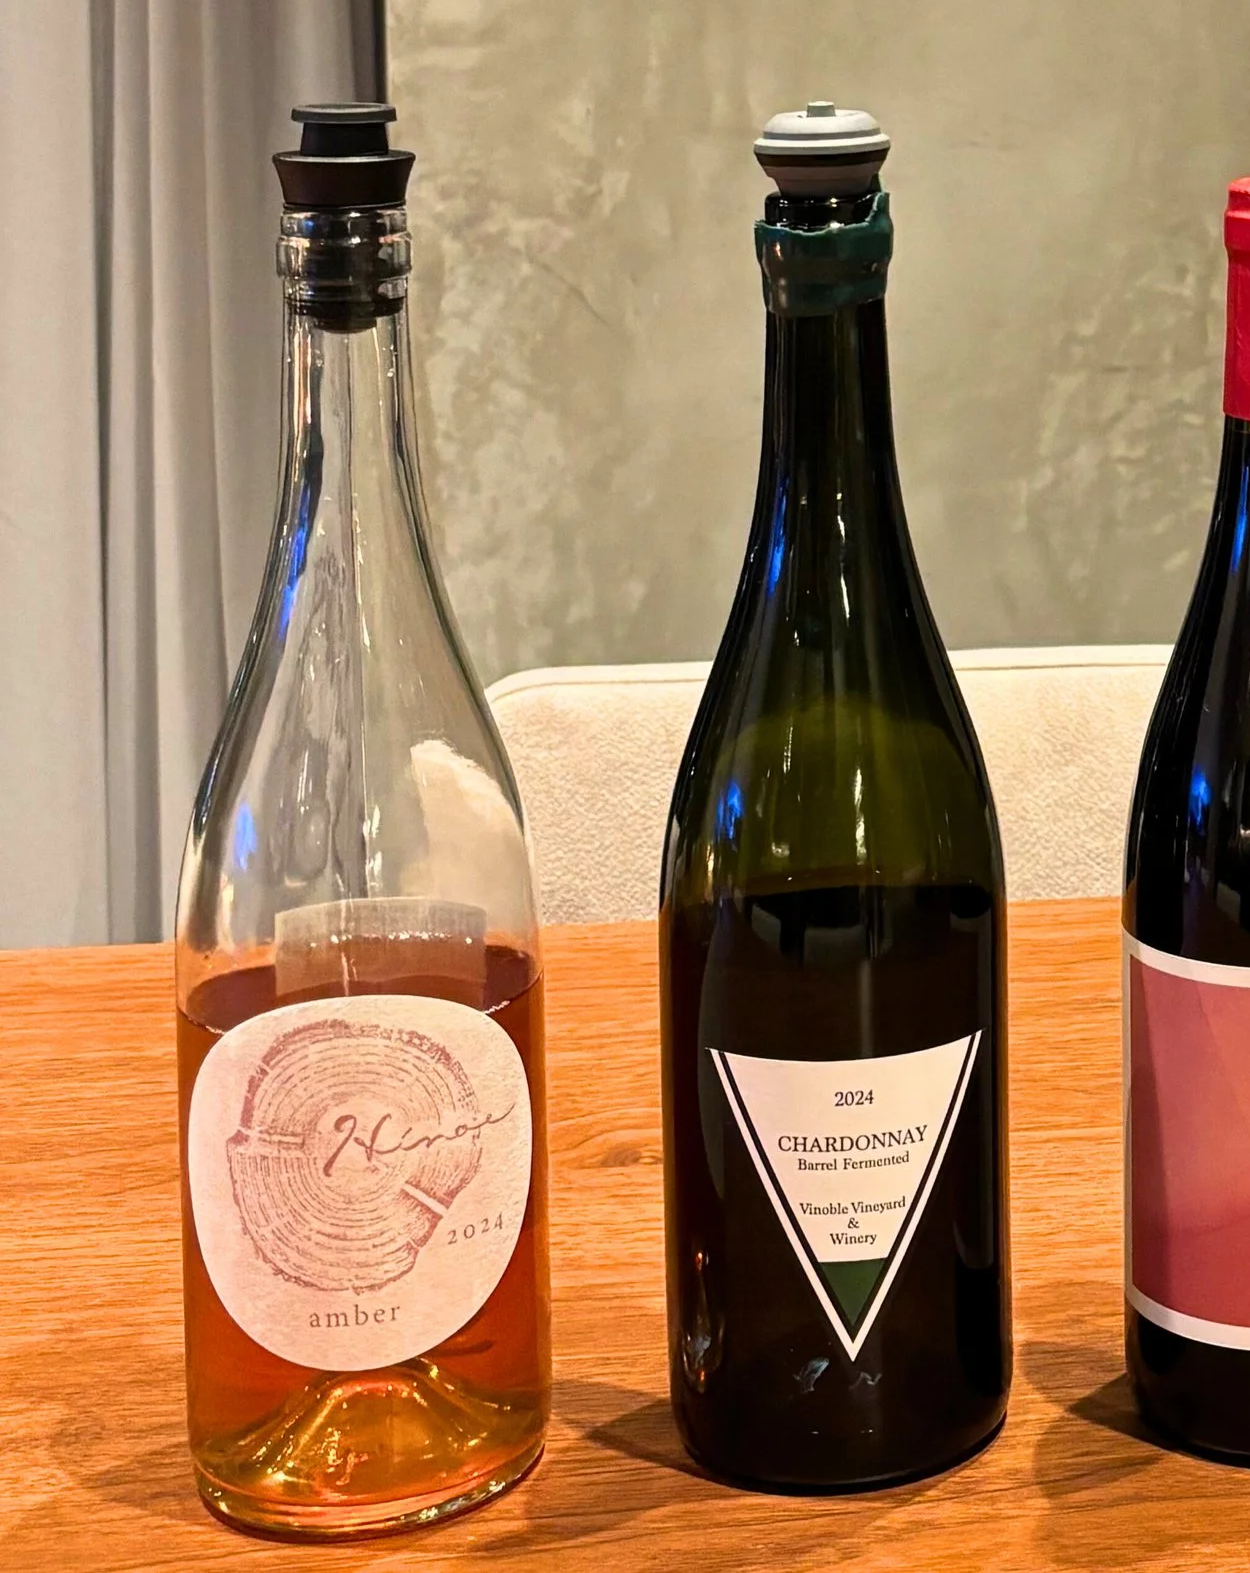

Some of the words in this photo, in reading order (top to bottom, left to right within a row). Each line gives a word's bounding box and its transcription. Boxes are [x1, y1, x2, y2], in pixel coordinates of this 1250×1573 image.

[834, 1089, 876, 1108] 2024
[777, 1124, 929, 1153] CHARDONNAY
[797, 1158, 838, 1172] Barrel
[842, 1151, 910, 1170] Fermented
[799, 1202, 849, 1216] Vinoble
[849, 1196, 907, 1215] Vineyard
[447, 1213, 505, 1246] 2024
[847, 1217, 860, 1229] &
[829, 1232, 878, 1245] Winery
[308, 1303, 402, 1329] amber
